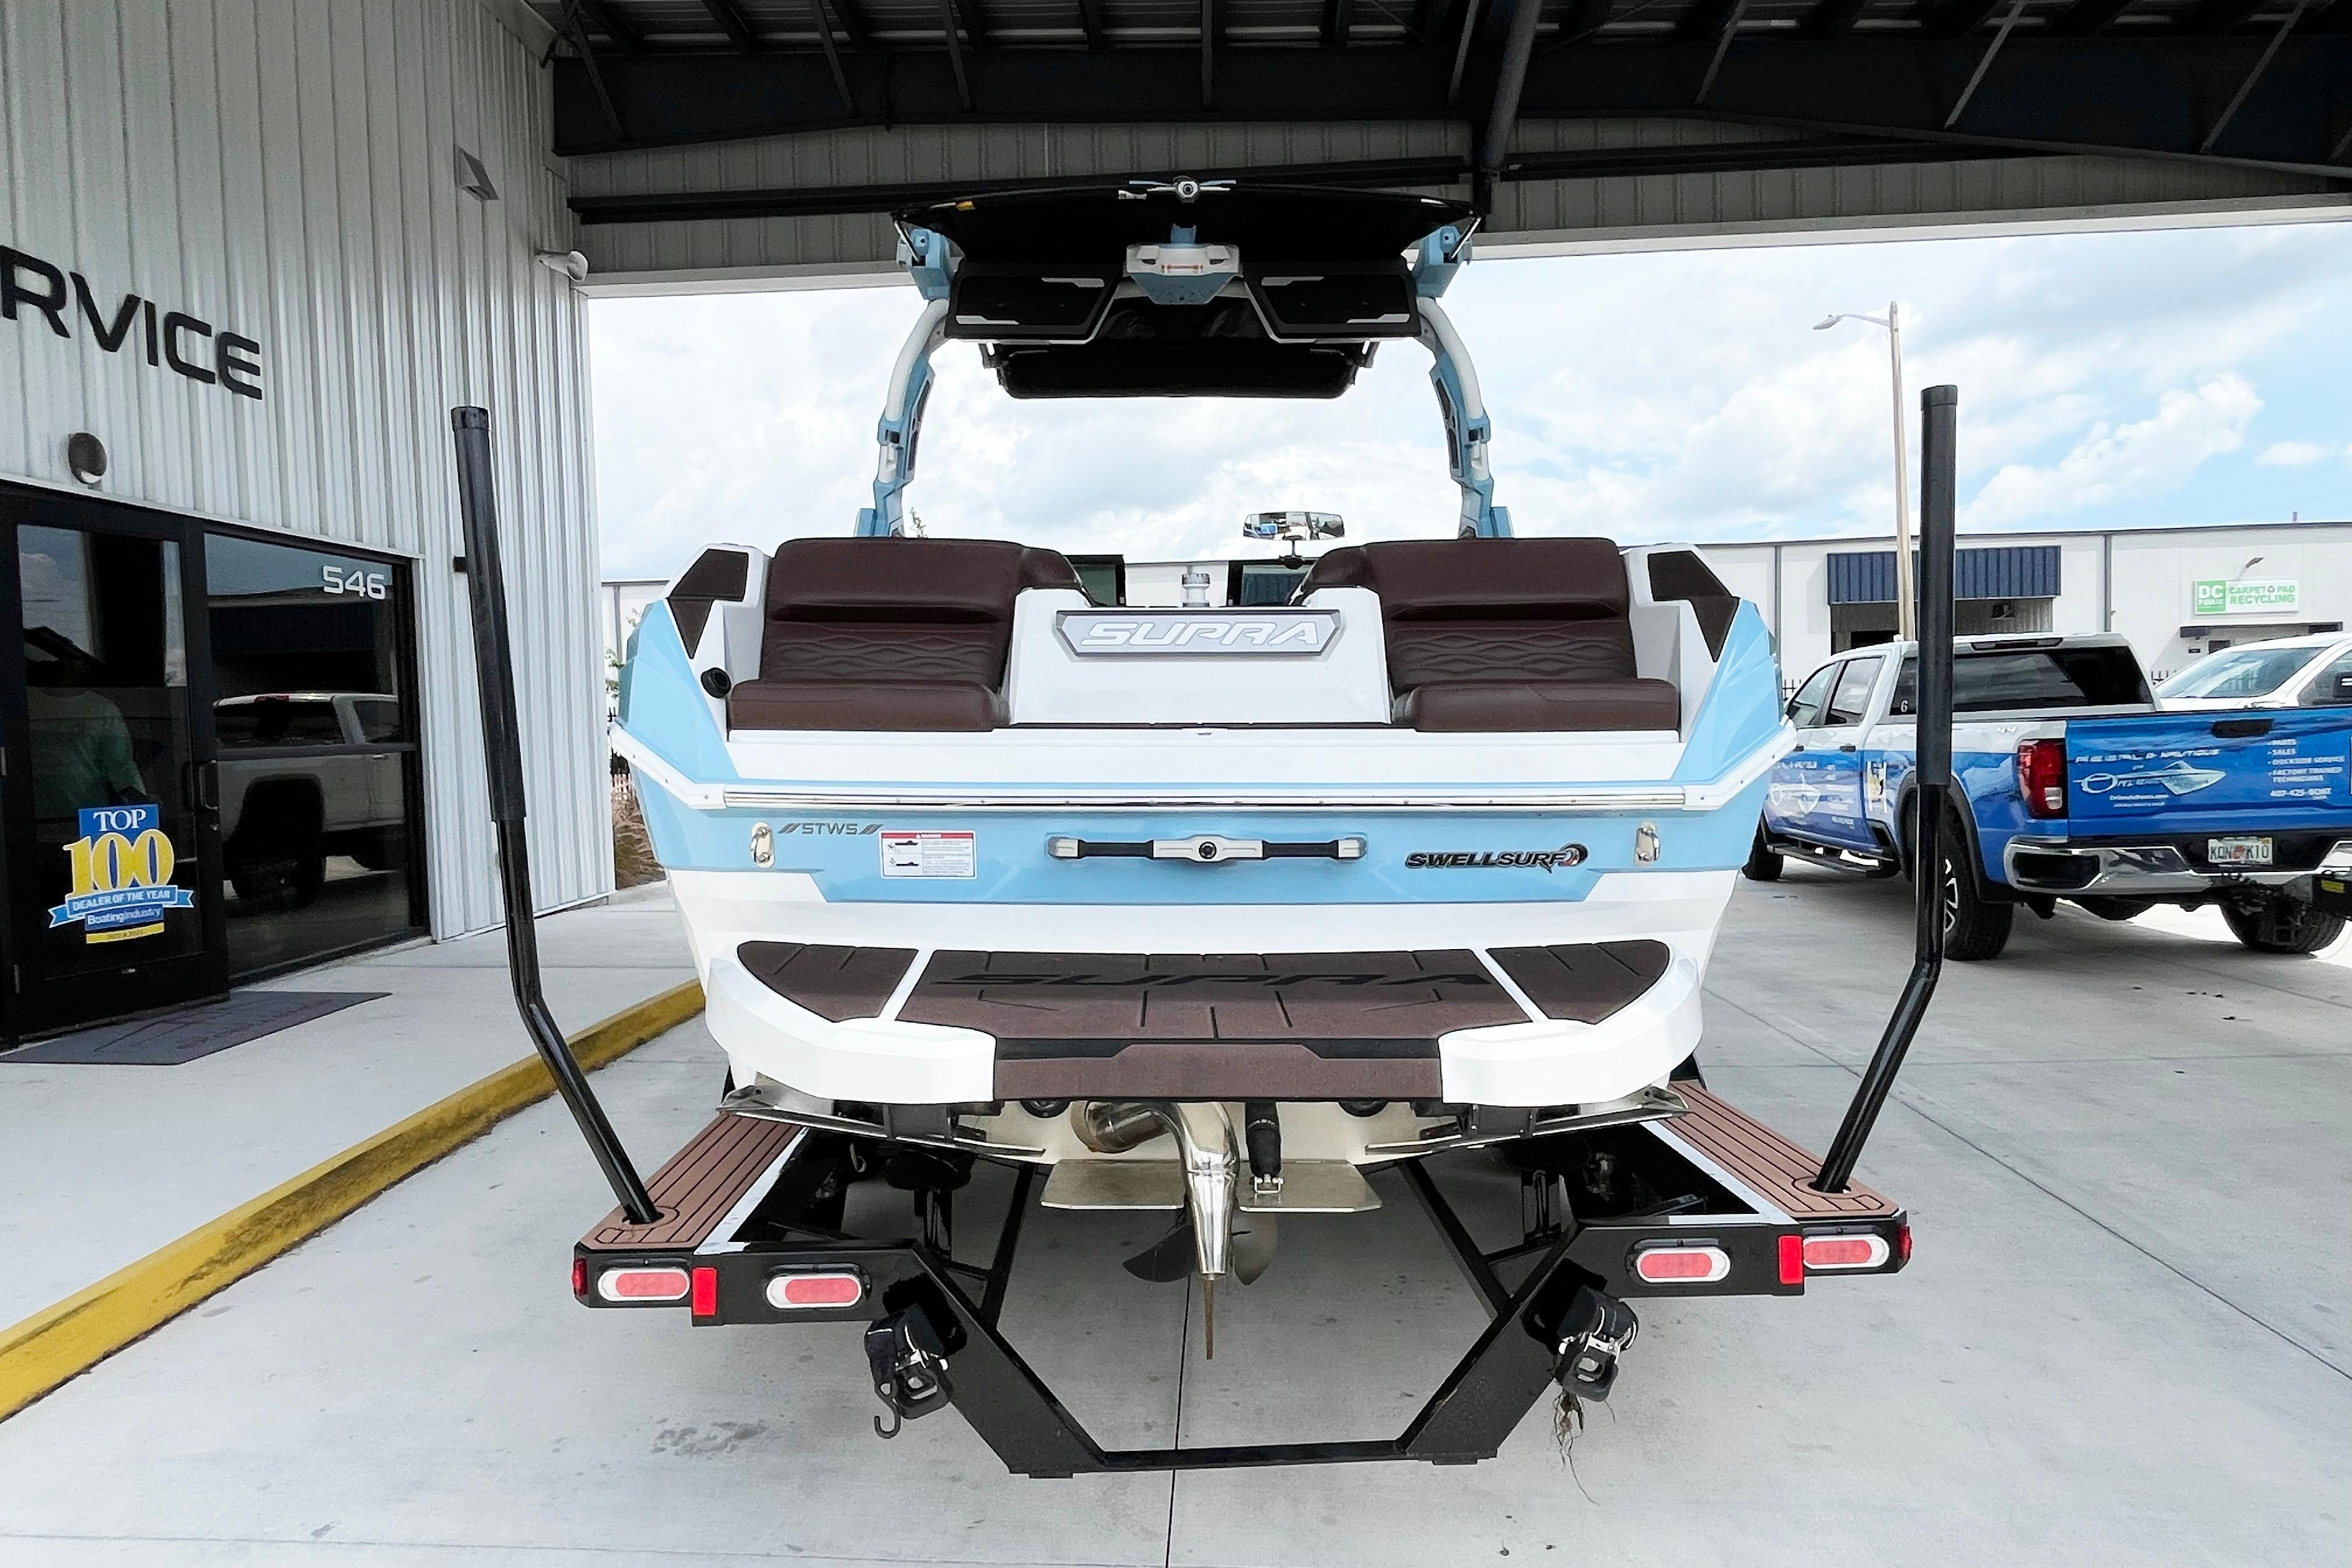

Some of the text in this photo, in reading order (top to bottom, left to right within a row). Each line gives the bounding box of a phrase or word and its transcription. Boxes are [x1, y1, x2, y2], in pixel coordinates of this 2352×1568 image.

[323, 564, 387, 600] 546
[2198, 584, 2224, 598] DC
[2230, 594, 2295, 604] RECYCLING
[1080, 621, 1320, 646] SUPRA
[1901, 700, 1908, 712] 6
[93, 808, 146, 831] TOP
[62, 829, 175, 898] 100
[1405, 850, 1569, 874] SWELLSURF
[72, 890, 170, 911] DEALER OF THE YEAR
